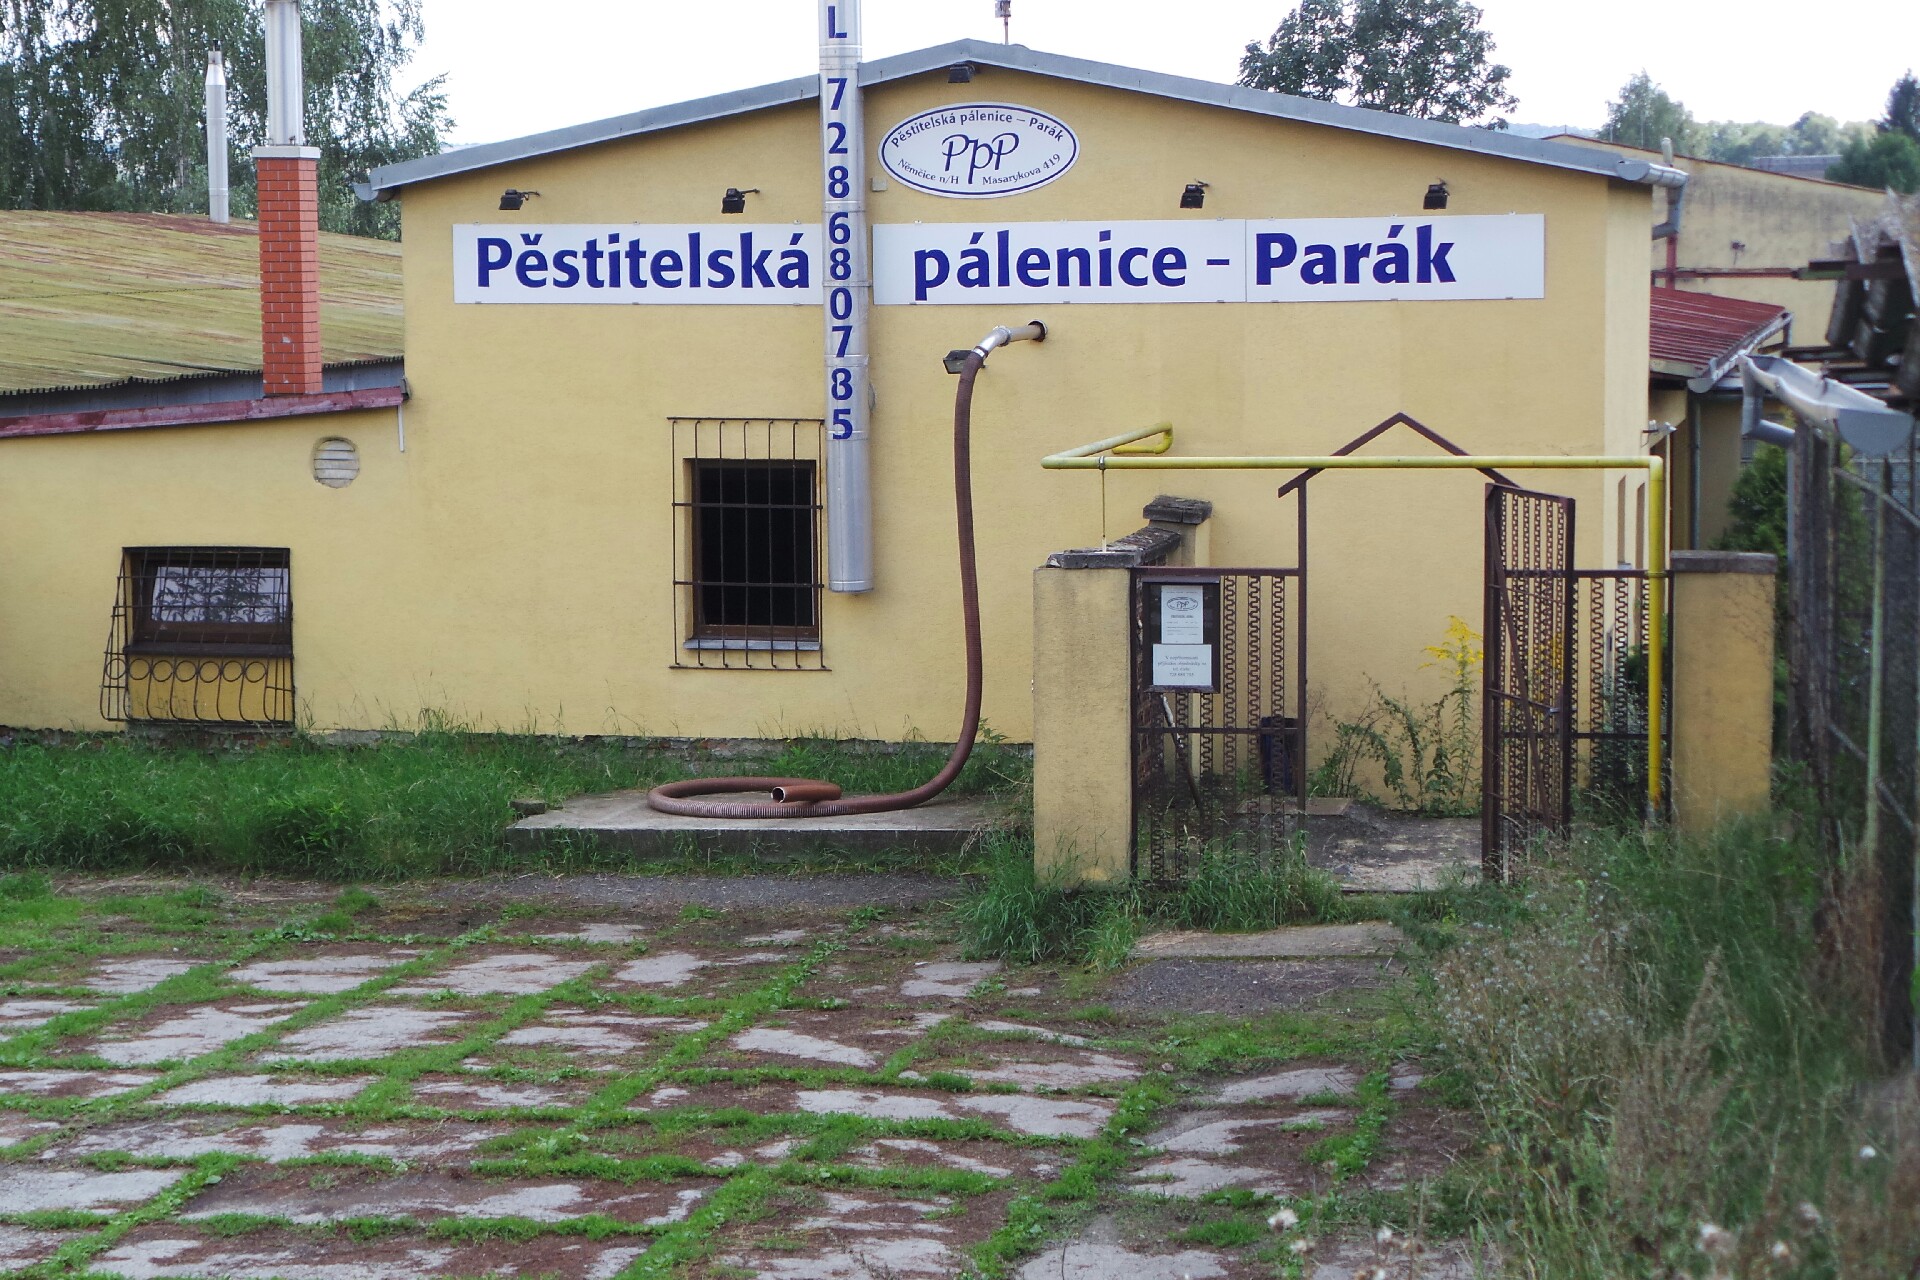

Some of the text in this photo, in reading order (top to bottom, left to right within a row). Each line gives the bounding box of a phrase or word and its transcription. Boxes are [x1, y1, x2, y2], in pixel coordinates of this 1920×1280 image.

[890, 112, 956, 149] Pěstitelská
[960, 109, 1013, 126] pálenice
[1029, 116, 1064, 143] Parák
[897, 152, 1062, 186] Němčice n/H Masarykova 419
[941, 132, 1020, 185] PpP
[477, 232, 809, 288] Pěstitelská
[914, 229, 1187, 301] pálenice
[1256, 224, 1457, 285] Parák
